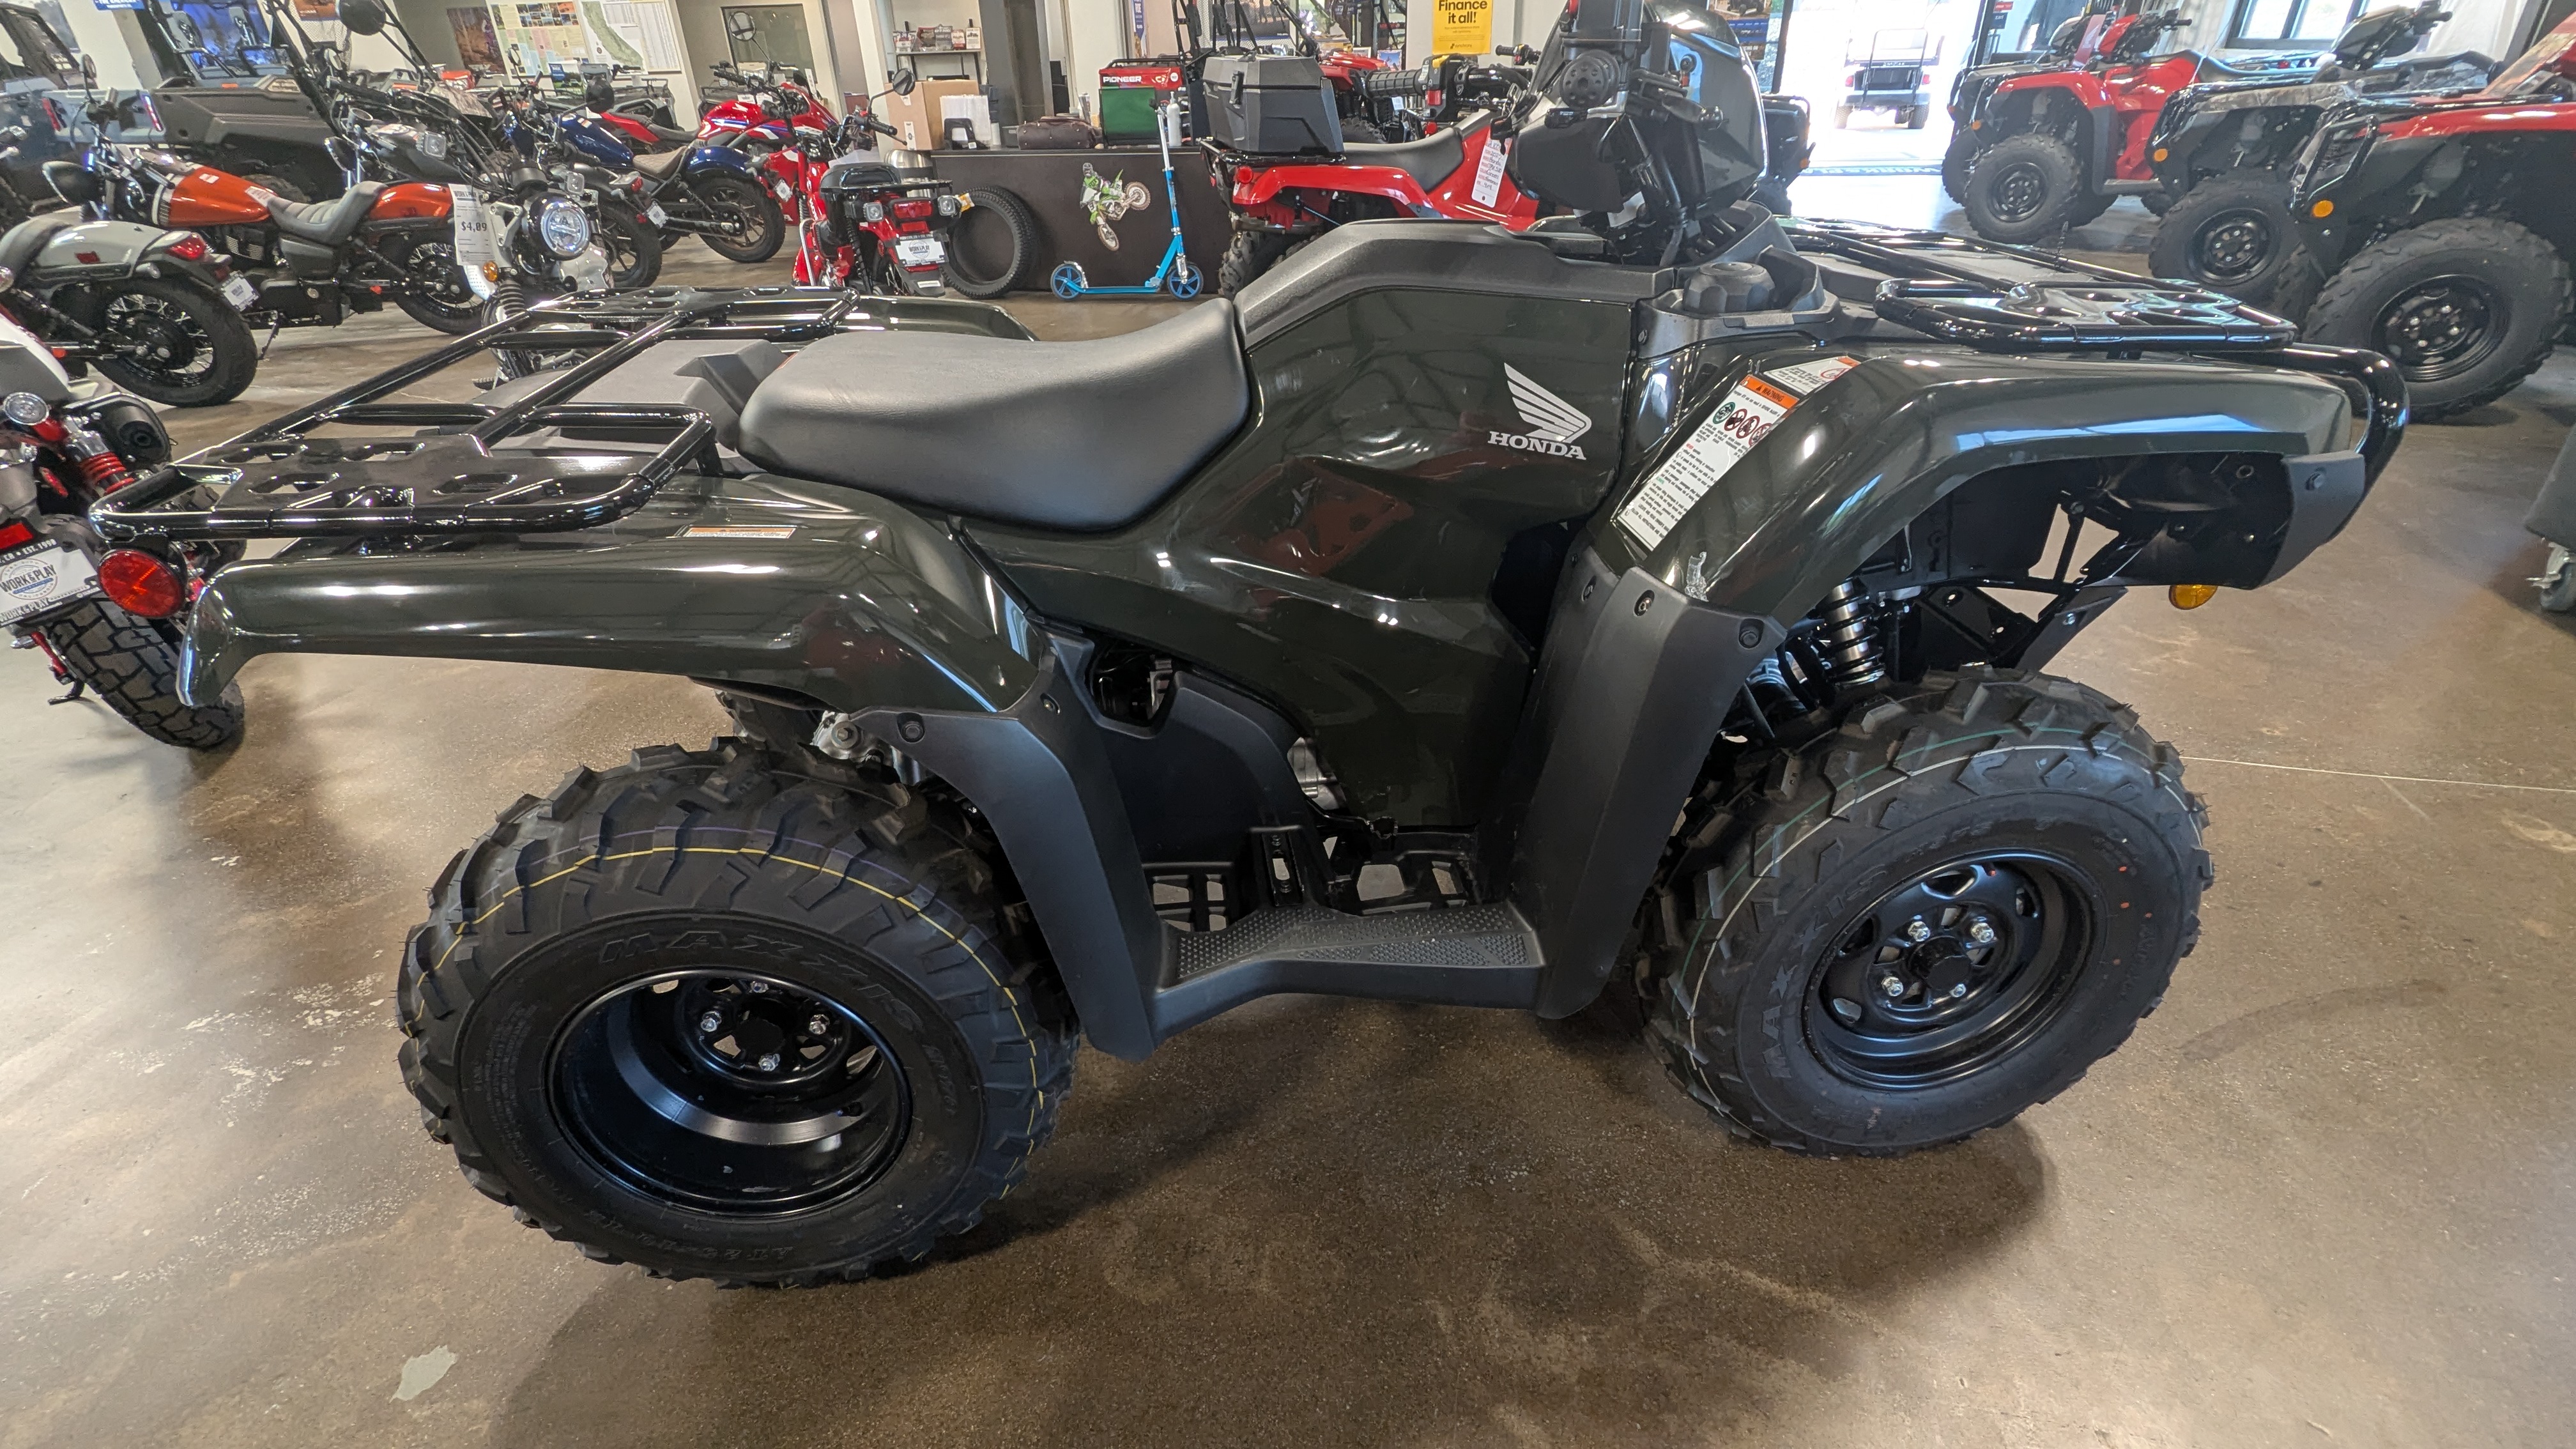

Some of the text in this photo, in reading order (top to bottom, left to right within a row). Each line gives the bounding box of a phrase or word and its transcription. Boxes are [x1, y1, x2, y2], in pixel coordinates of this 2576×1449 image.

[1439, 0, 1487, 11] Finance
[1448, 11, 1476, 24] it all!
[461, 221, 487, 233] $4,09
[1761, 387, 1785, 402] WARNING
[1487, 431, 1587, 460] HONDA
[0, 564, 57, 592] WORK&PLAY
